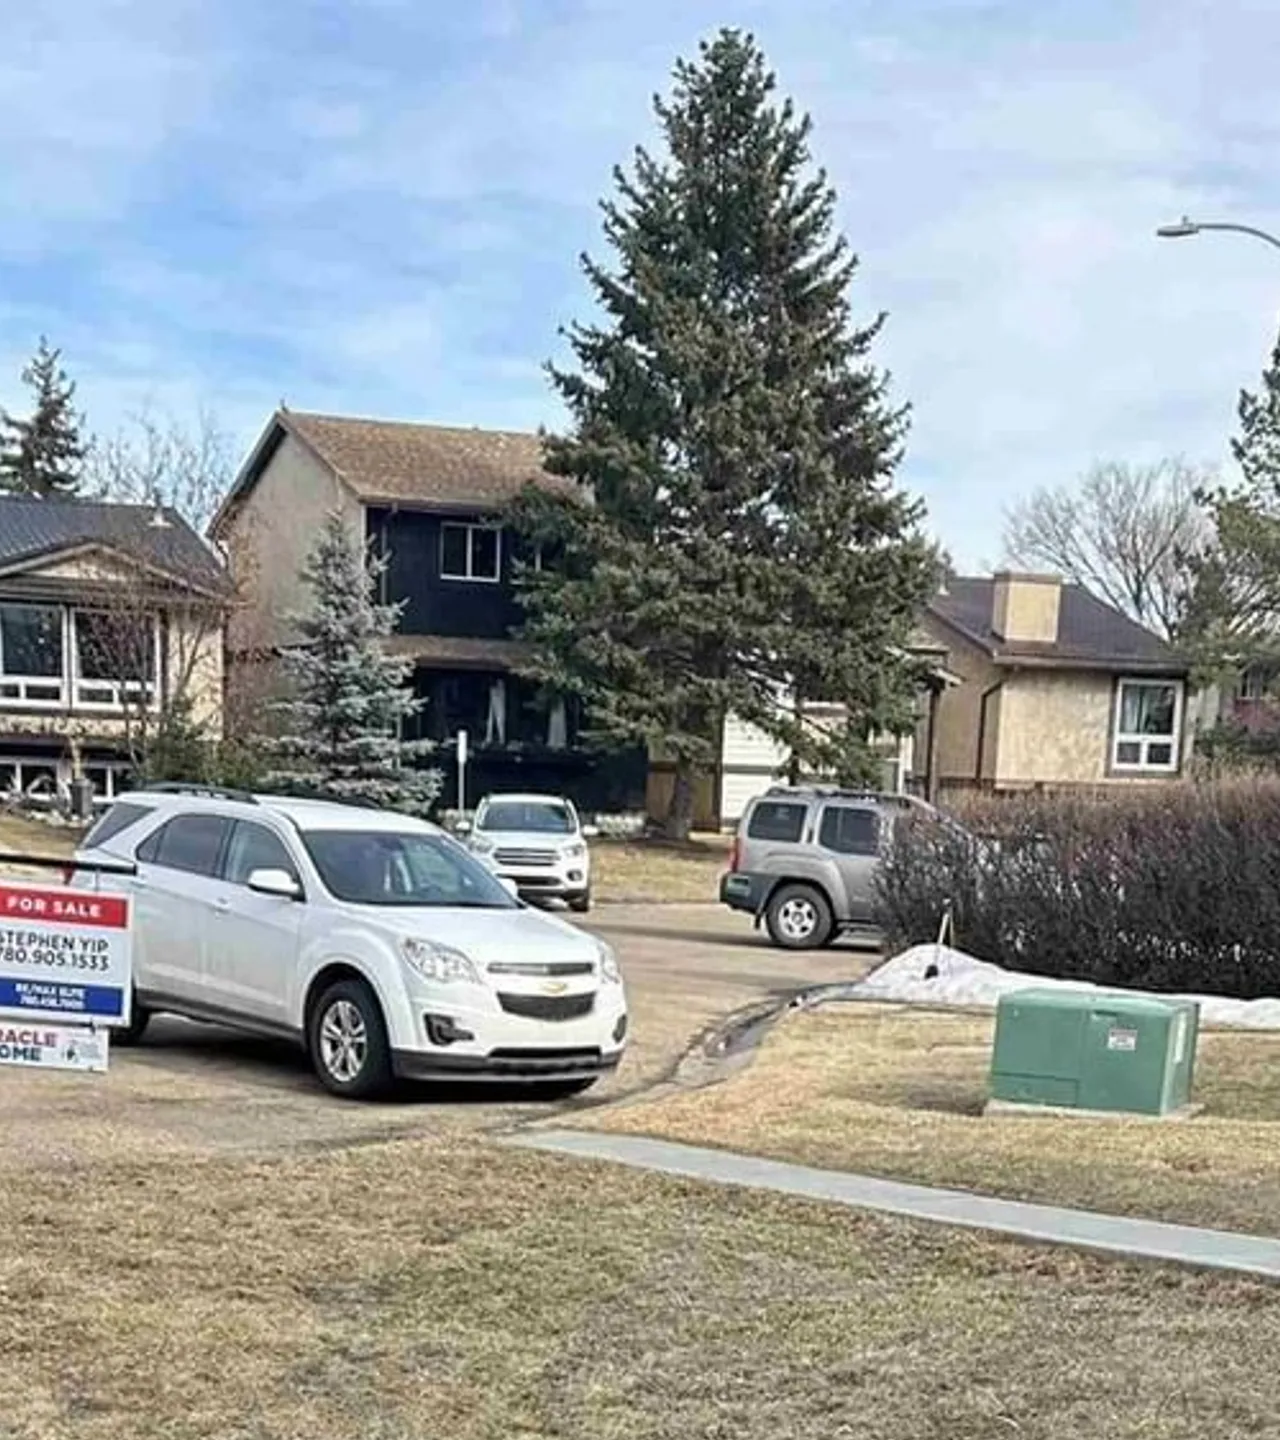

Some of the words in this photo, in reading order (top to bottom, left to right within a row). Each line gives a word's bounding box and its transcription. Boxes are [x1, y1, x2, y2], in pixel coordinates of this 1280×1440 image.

[7, 896, 46, 912] FOR
[53, 901, 101, 917] SALE
[79, 937, 109, 953] YIP
